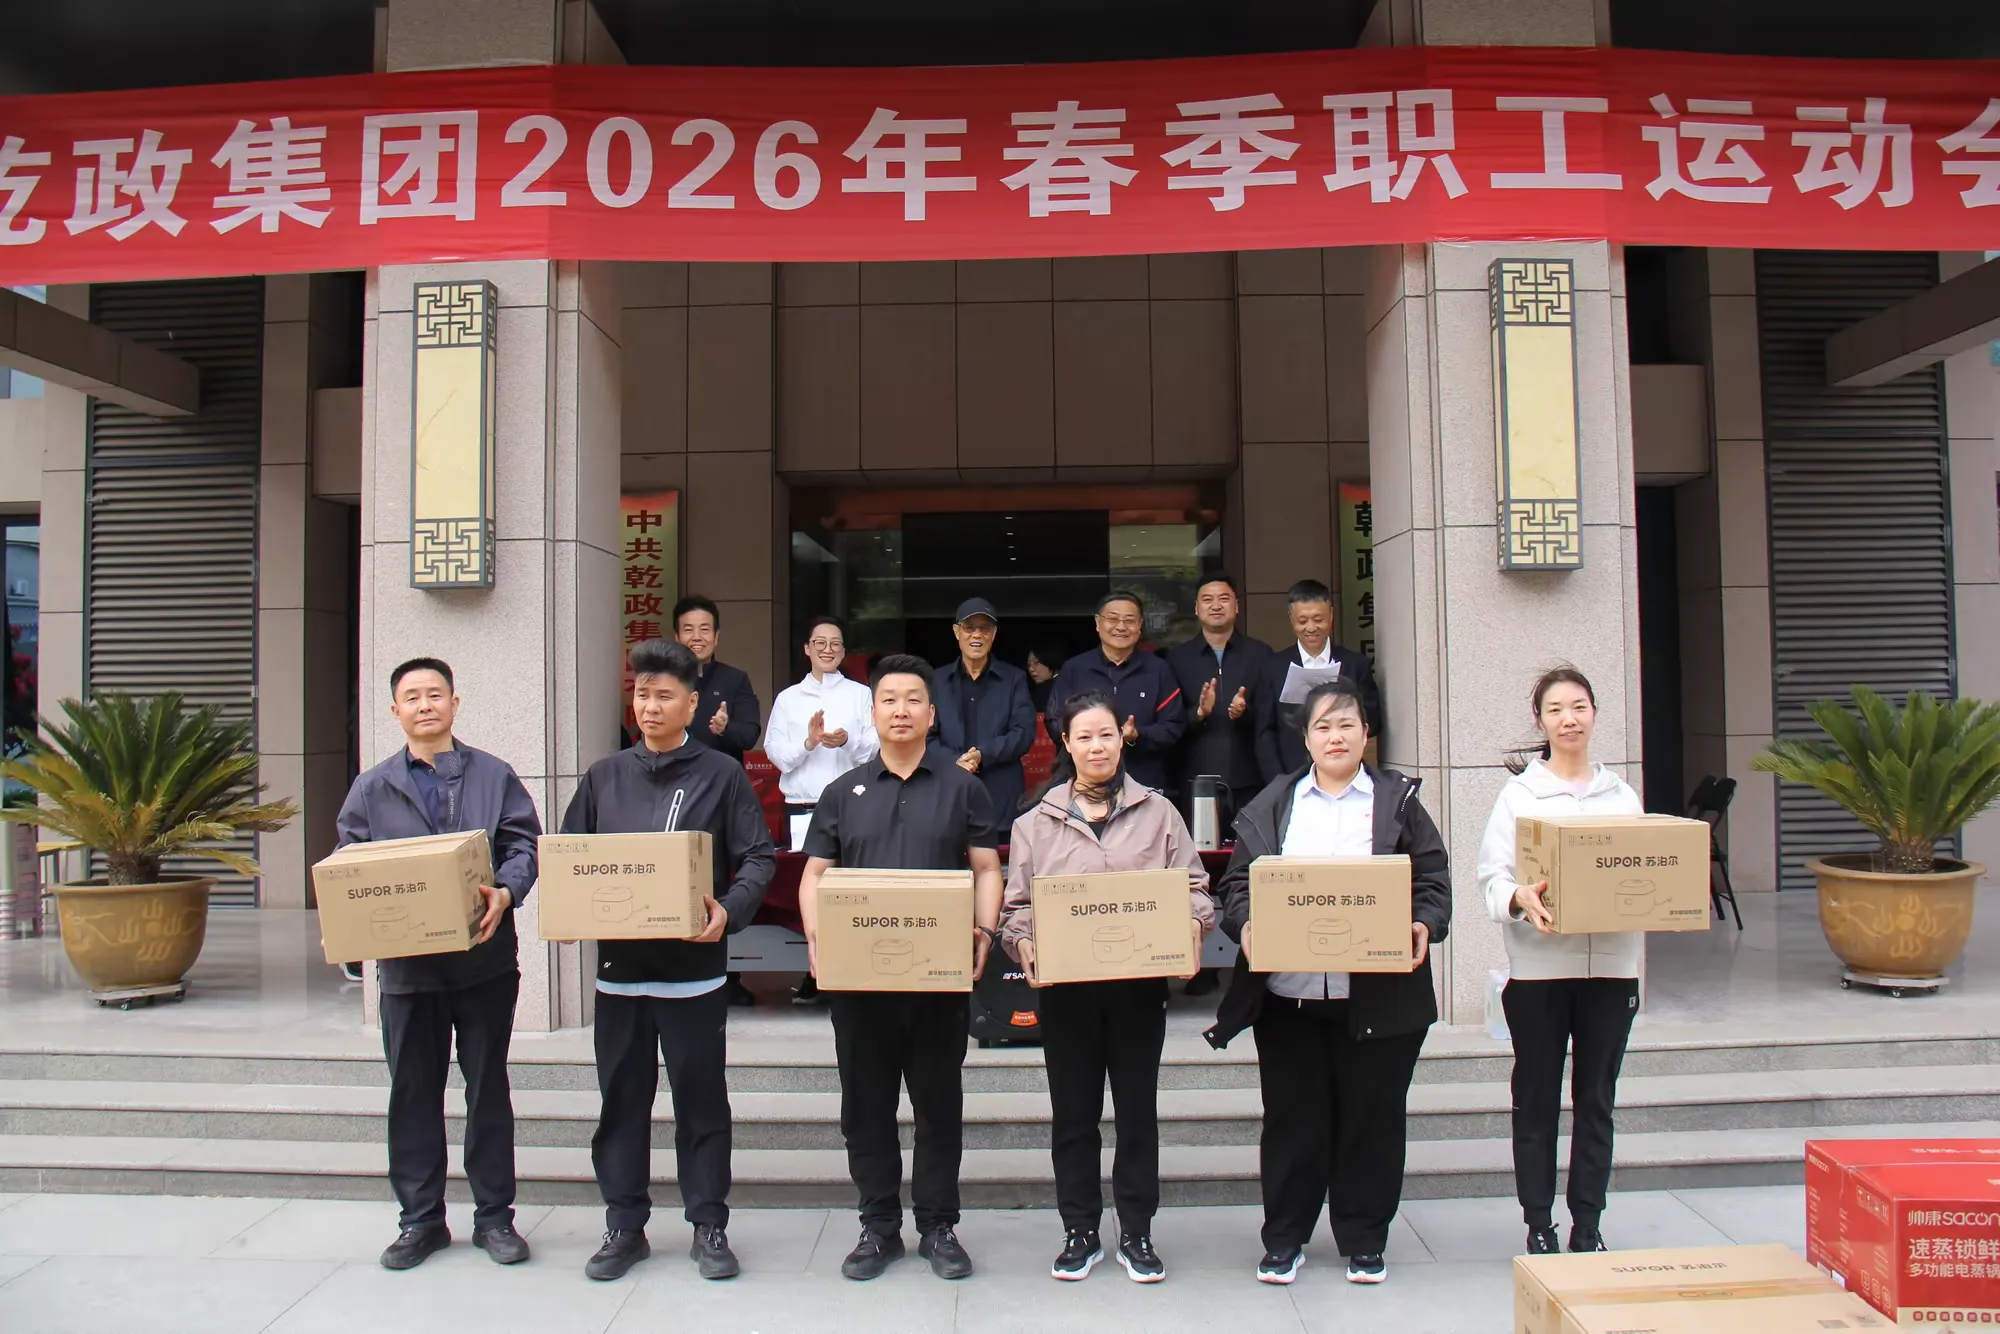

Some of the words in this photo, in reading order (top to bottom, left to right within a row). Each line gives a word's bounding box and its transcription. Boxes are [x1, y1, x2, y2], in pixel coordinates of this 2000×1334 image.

[623, 509, 664, 727] 中共乾政集
[1596, 856, 1642, 868] SUPOR
[1645, 856, 1679, 867] 苏泊尔
[573, 864, 619, 875] SUPOR
[622, 864, 656, 874] 苏泊尔
[347, 885, 392, 900] SUPOR
[395, 882, 427, 894] 苏泊尔
[1287, 895, 1337, 906] SUPOR
[1340, 895, 1377, 906] 苏泊尔
[1070, 903, 1119, 916] SUPOR
[1122, 901, 1158, 913] 苏泊尔
[852, 917, 900, 928] SUPOR
[903, 917, 938, 928] 苏泊尔
[1909, 1237, 2000, 1261] 速蒸锁鲜
[1611, 1264, 1677, 1273] SUPOR
[1681, 1262, 1728, 1270] 苏泊尔
[1909, 1262, 2000, 1278] 多功能电蒸锅
